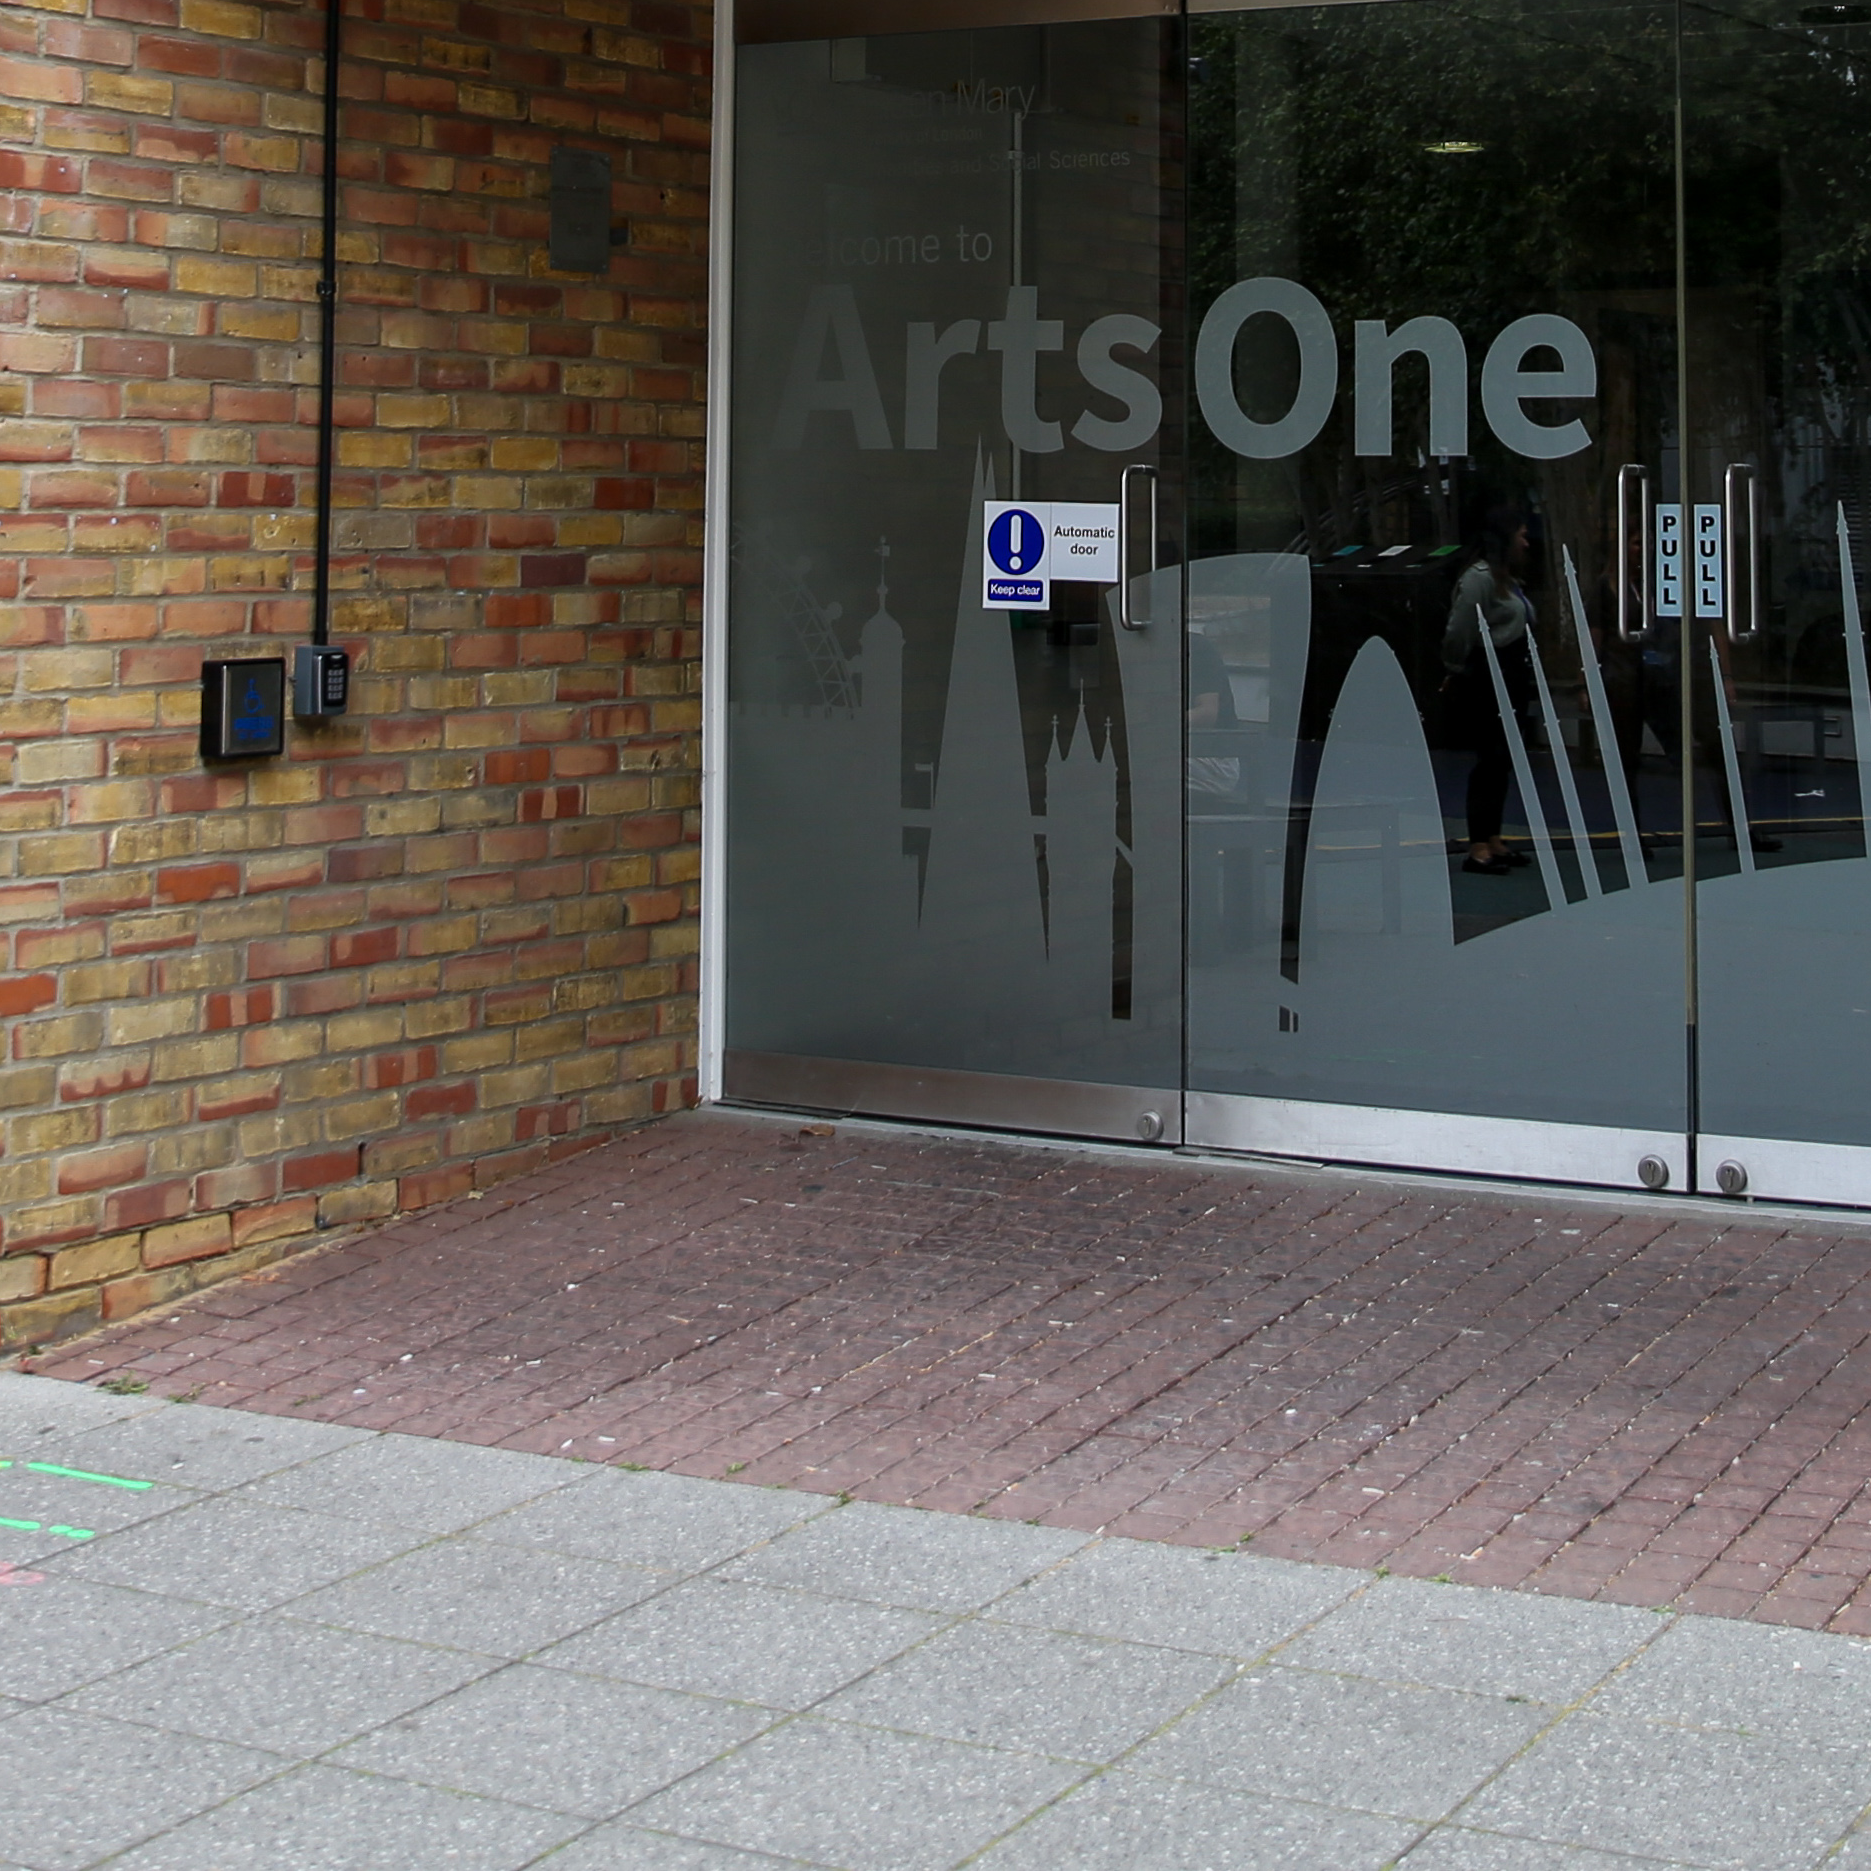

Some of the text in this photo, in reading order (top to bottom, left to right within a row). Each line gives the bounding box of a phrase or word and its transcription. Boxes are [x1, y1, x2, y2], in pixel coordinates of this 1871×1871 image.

[957, 78, 1036, 121] Mary
[1049, 150, 1131, 170] Sciences
[802, 224, 994, 268] elcome to
[770, 277, 1597, 460] ArtsOne
[1054, 525, 1115, 538] Automatic
[1070, 543, 1099, 556] door
[1661, 515, 1678, 605] PULL
[1700, 515, 1716, 606] PULL
[990, 583, 1041, 597] Keep clear
